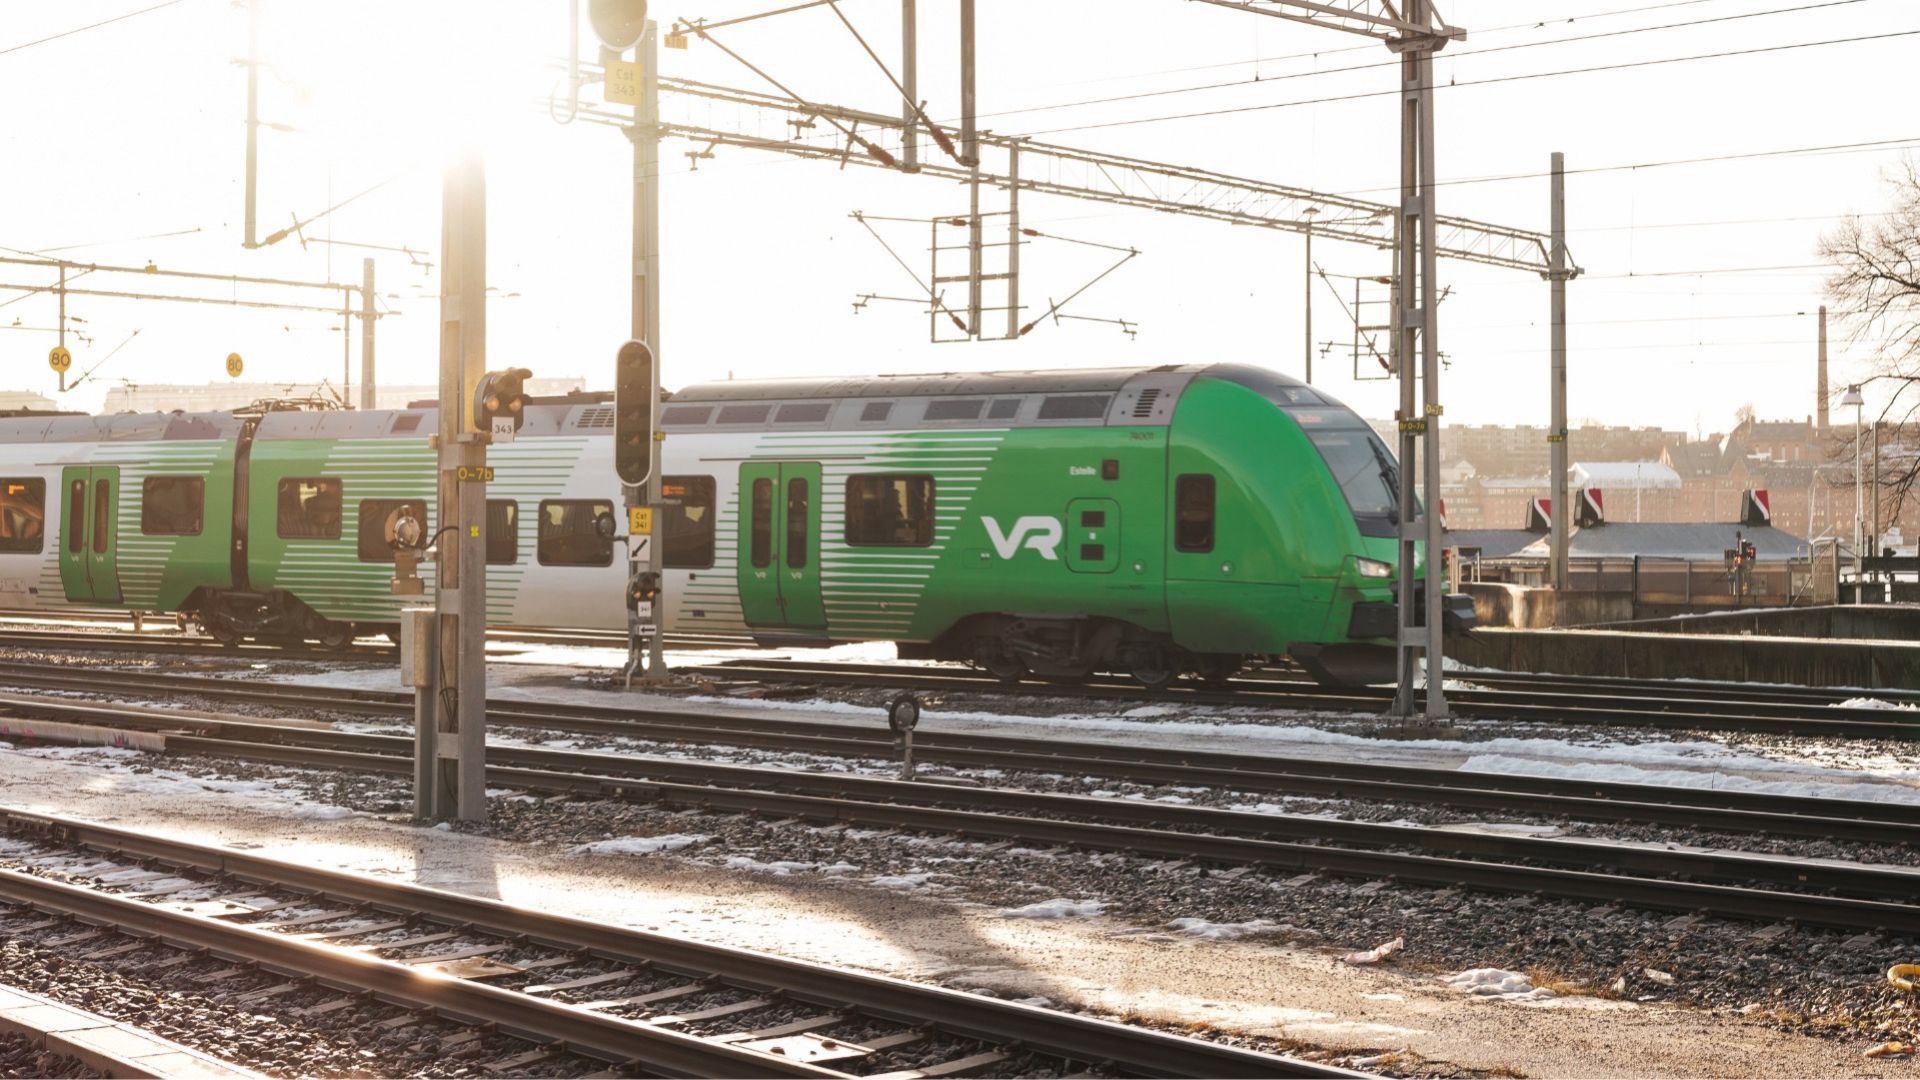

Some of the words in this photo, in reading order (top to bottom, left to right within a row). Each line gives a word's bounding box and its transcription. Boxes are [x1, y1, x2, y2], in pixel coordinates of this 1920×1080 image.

[51, 353, 71, 367] 80
[228, 359, 243, 371] 80
[494, 424, 512, 434] 343
[980, 516, 1063, 560] VR
